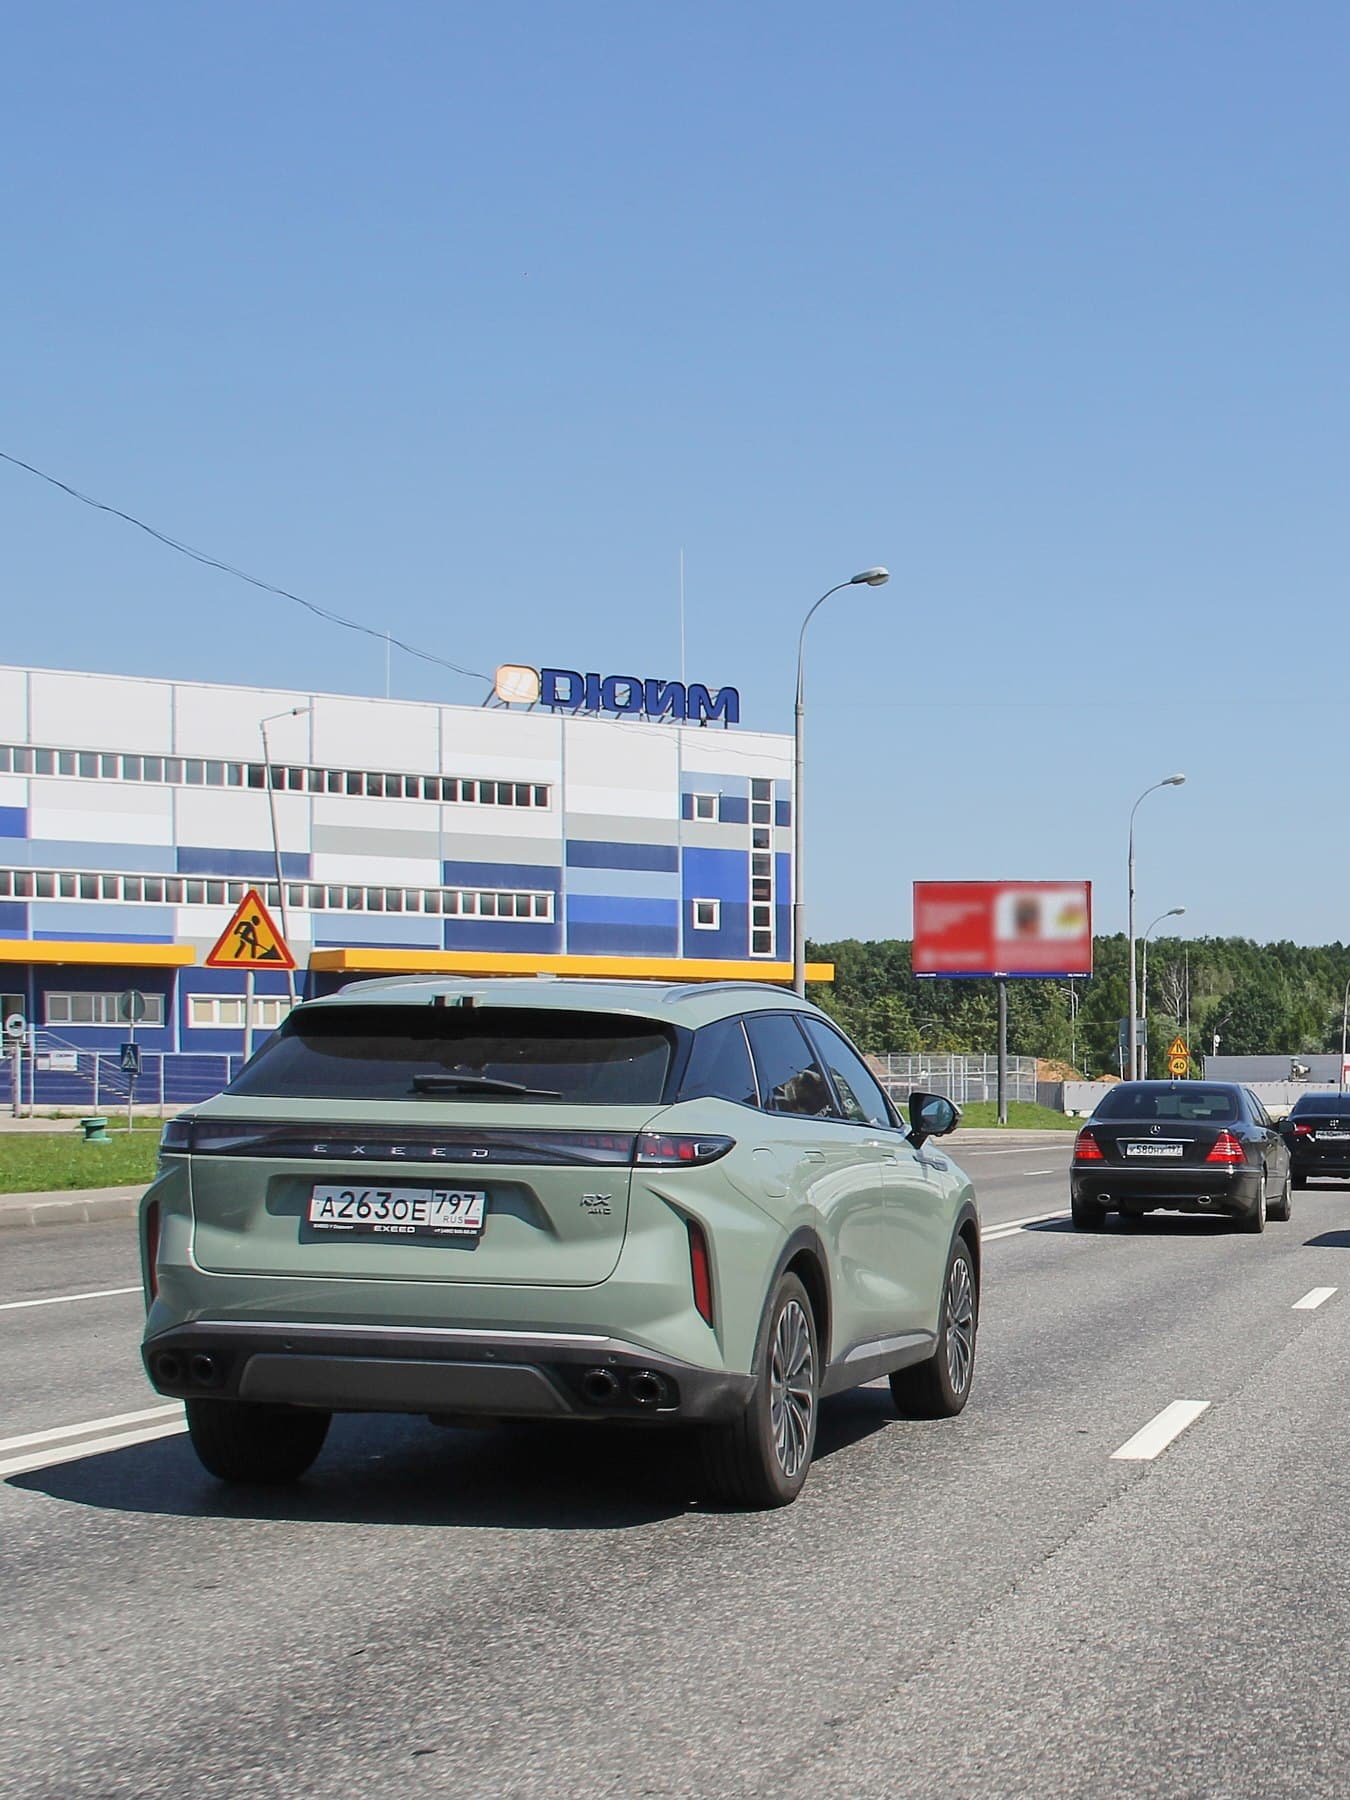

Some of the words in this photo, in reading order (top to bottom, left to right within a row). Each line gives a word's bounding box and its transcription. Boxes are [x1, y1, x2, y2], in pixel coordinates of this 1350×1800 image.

[313, 1143, 489, 1158] EXEED
[434, 1192, 477, 1215] 797
[443, 1215, 464, 1225] RUS
[373, 1224, 416, 1233] EXEED
